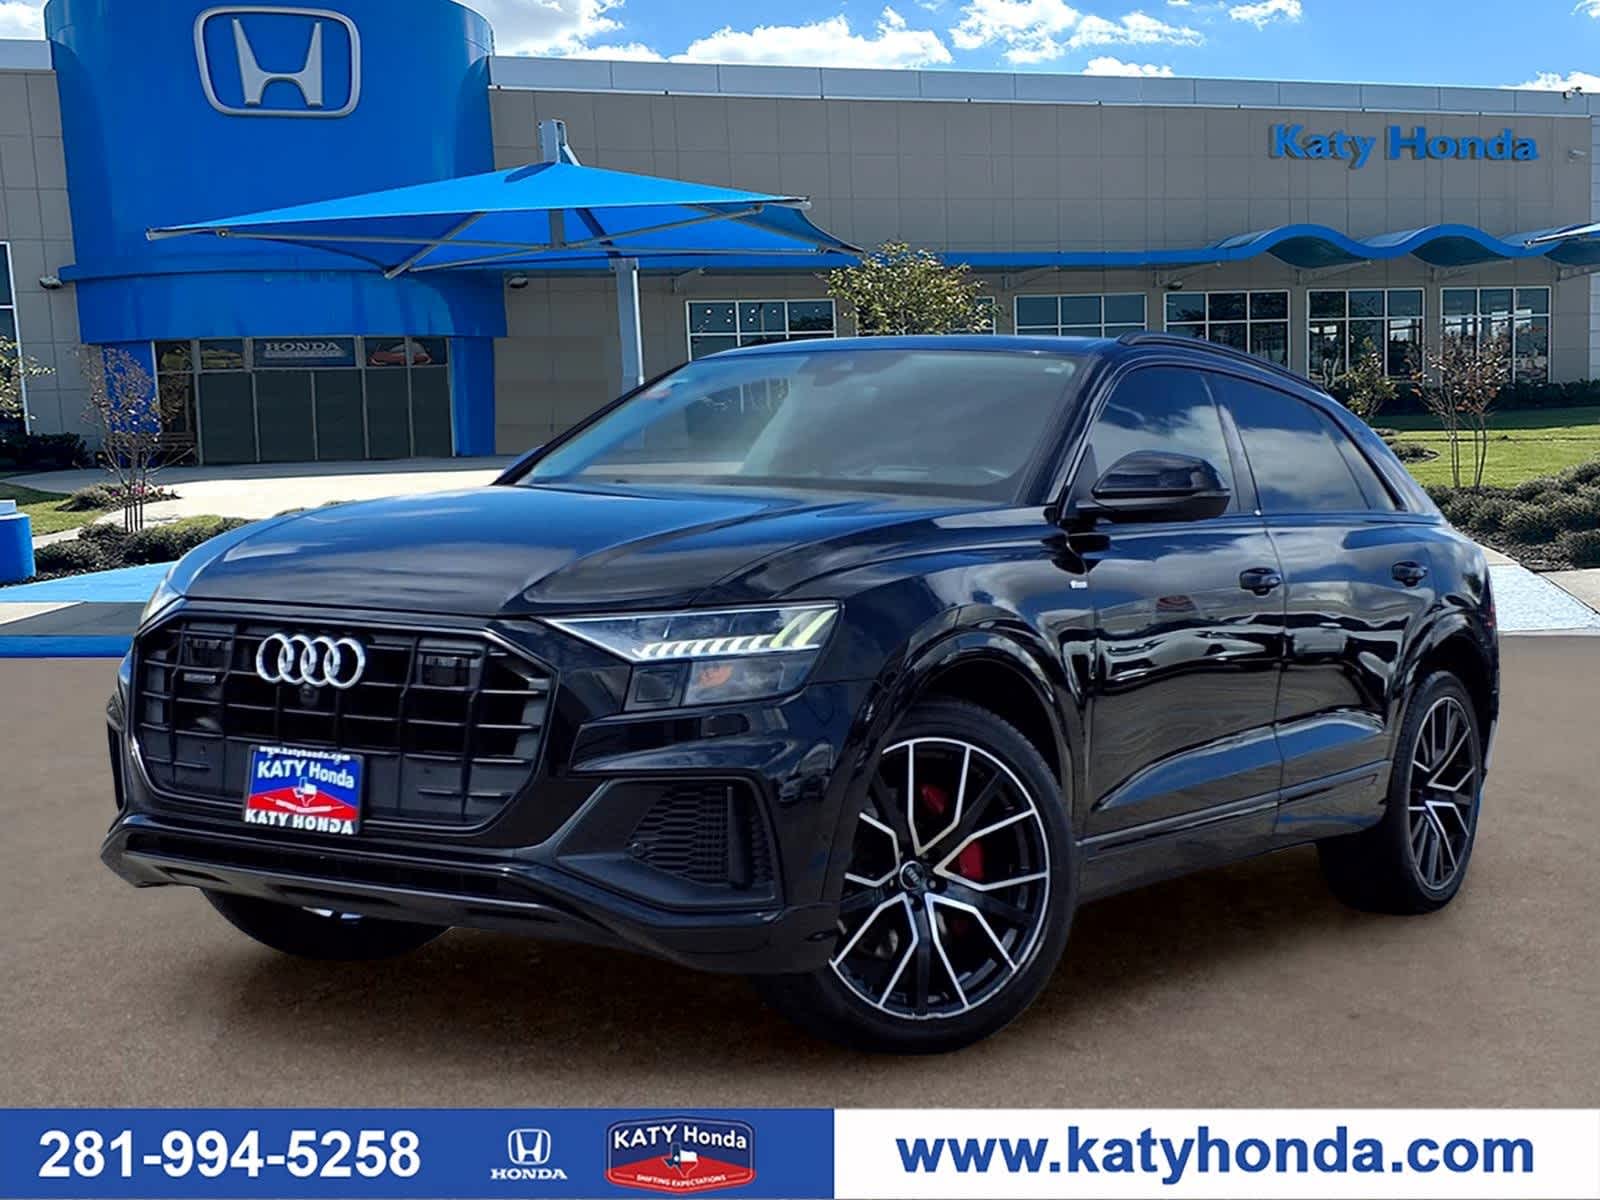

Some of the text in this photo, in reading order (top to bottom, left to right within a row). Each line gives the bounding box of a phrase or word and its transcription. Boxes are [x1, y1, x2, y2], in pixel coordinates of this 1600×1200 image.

[1269, 123, 1539, 169] Katy Honda
[264, 342, 344, 353] HONDA
[257, 760, 355, 789] KATY Honda
[245, 808, 354, 834] KATY HONDA
